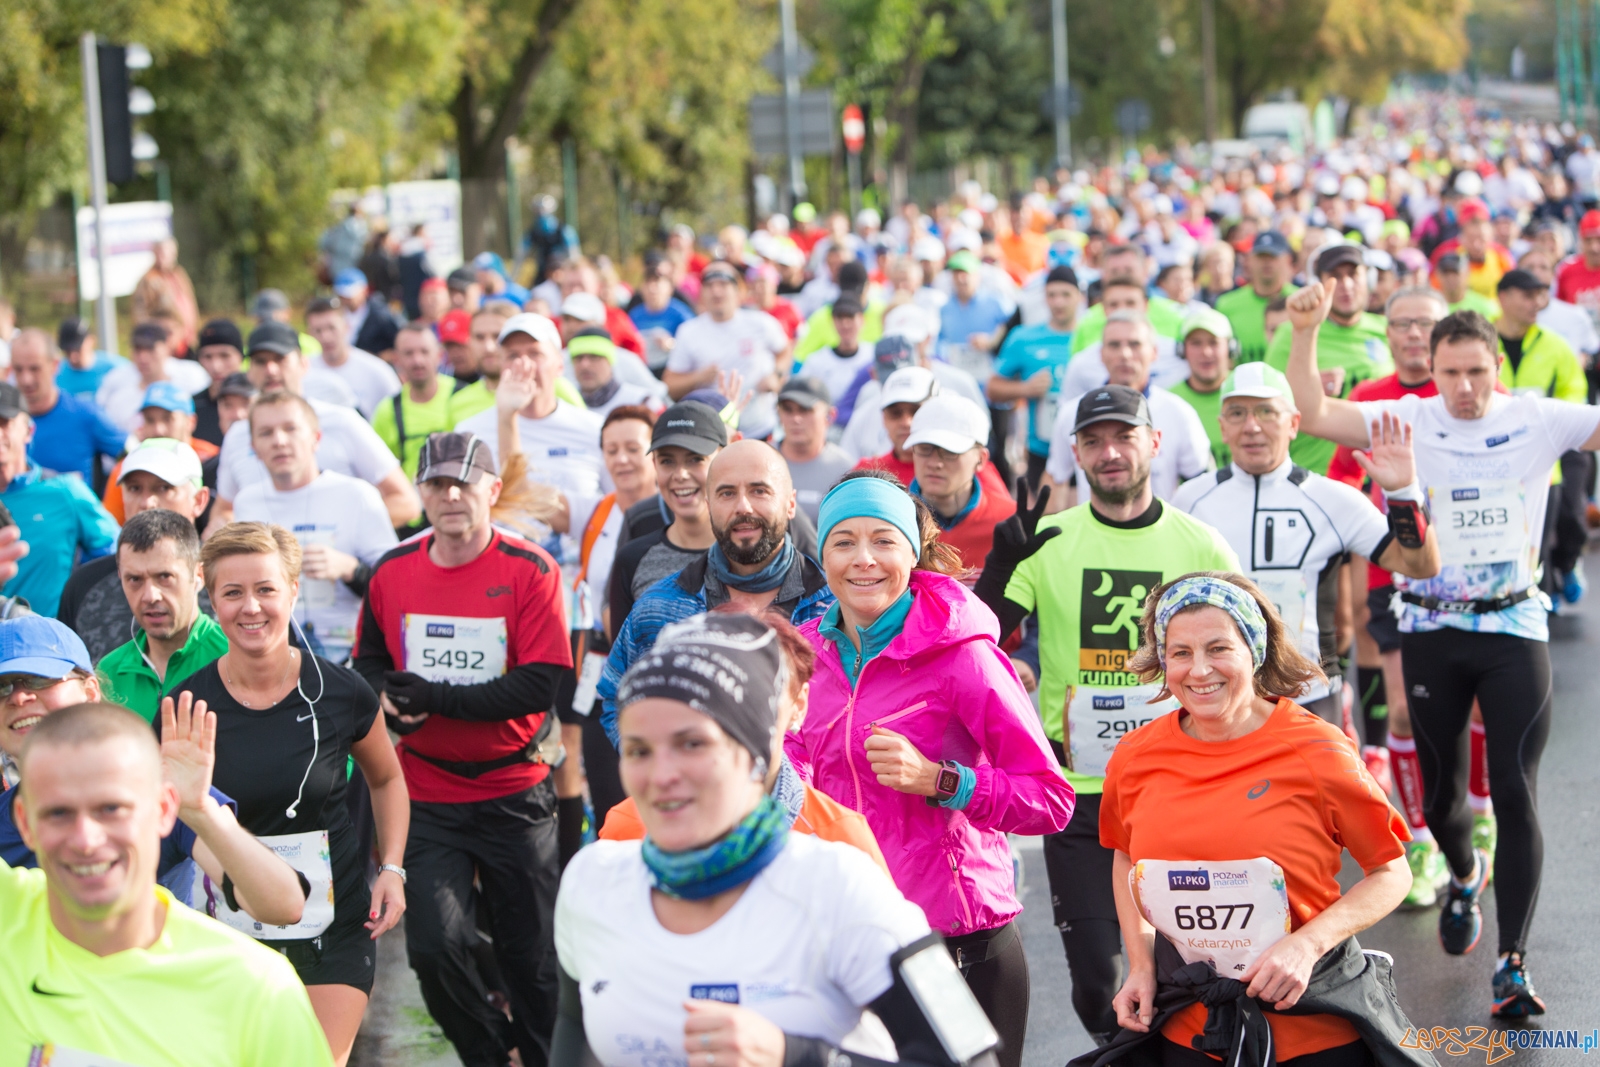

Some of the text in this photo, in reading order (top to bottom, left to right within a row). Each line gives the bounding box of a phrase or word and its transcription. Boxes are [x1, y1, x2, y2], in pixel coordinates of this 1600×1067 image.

[667, 419, 696, 428] Reebok
[1452, 507, 1508, 529] 3263
[423, 648, 485, 670] 5492
[1096, 650, 1129, 670] nig
[1080, 670, 1139, 686] runne
[1096, 719, 1153, 738] 291
[1171, 874, 1206, 886] 17.PKO
[1213, 879, 1249, 887] maraton
[1174, 903, 1255, 931] 6877
[1187, 937, 1252, 950] Katarzyna
[1233, 963, 1246, 972] 4F
